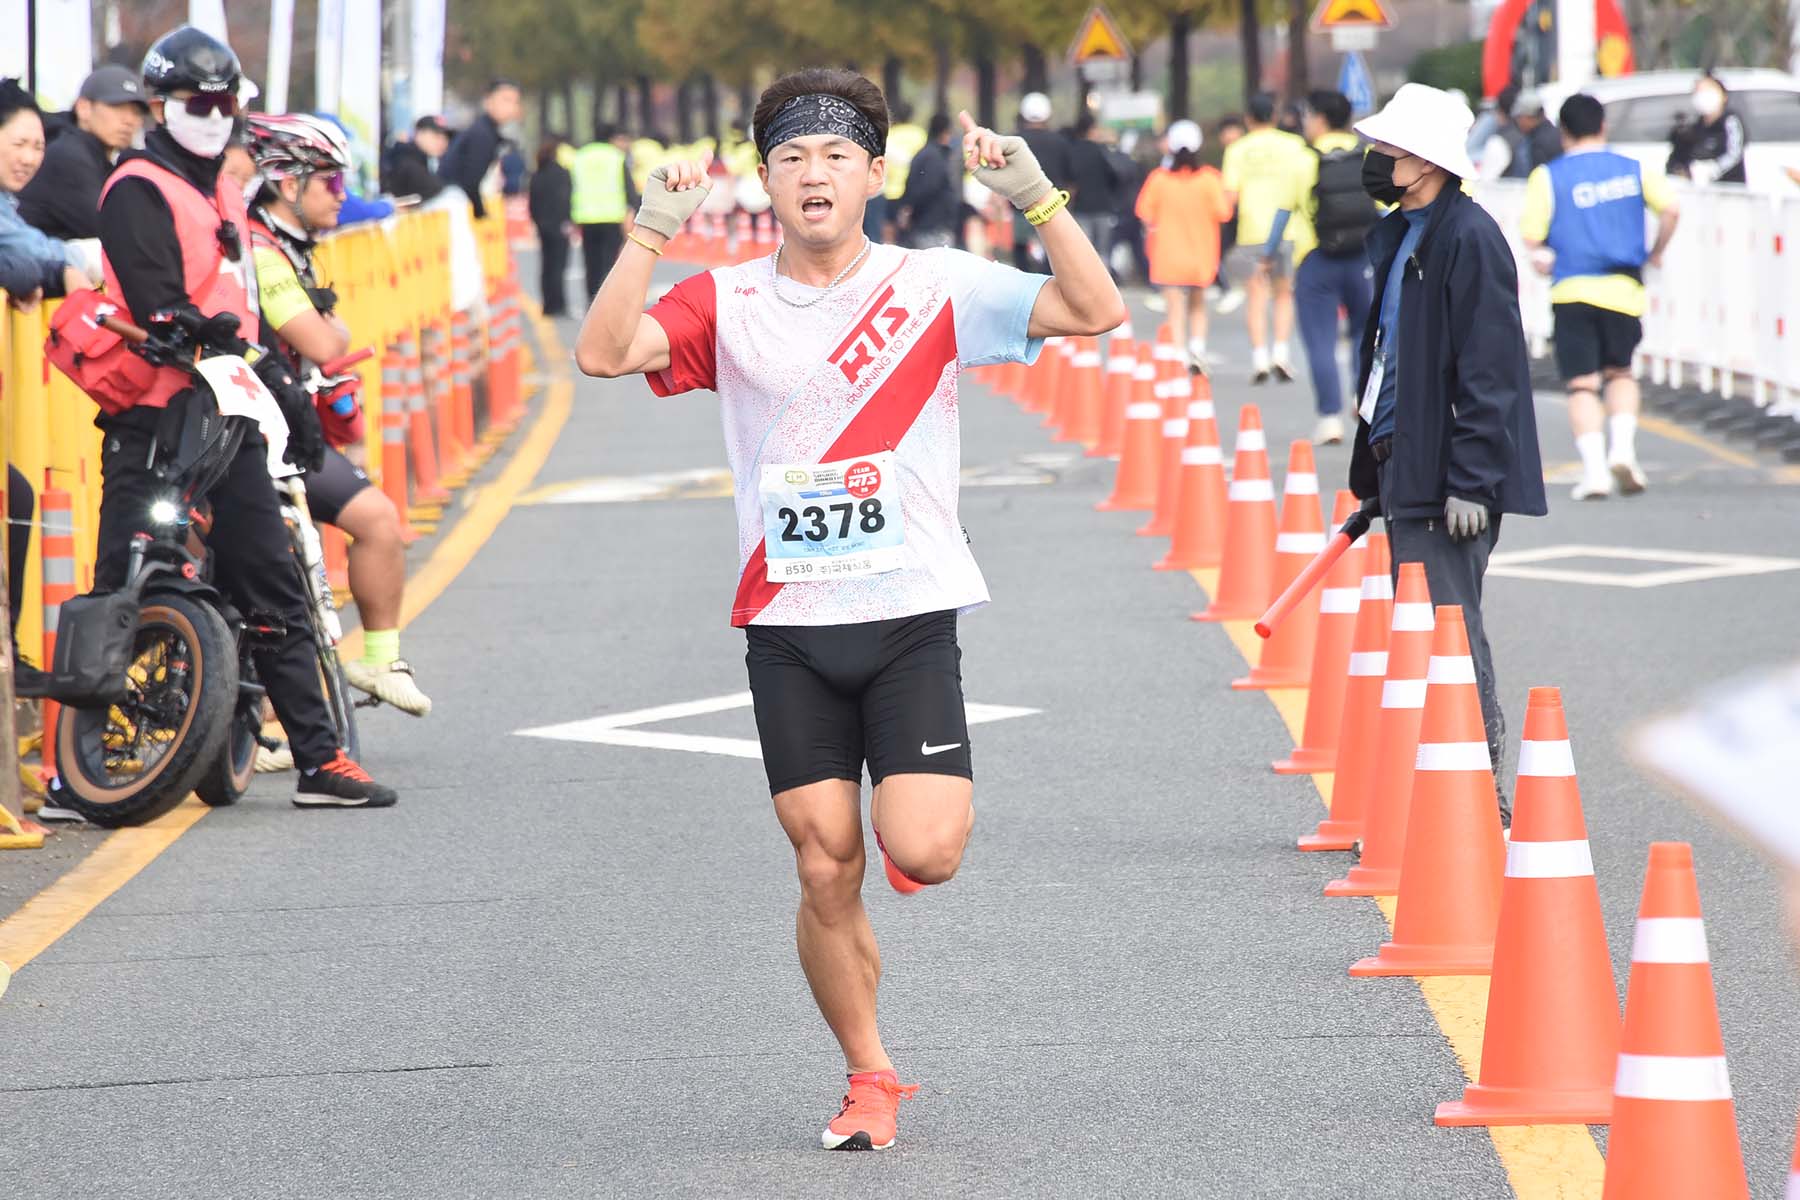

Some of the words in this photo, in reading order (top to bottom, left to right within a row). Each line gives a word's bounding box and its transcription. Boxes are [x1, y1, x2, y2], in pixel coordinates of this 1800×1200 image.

[847, 355, 892, 405] RUNNING
[888, 339, 904, 355] TO
[901, 317, 922, 339] THE
[919, 292, 938, 318] SKY
[853, 466, 870, 474] TEAM
[778, 497, 885, 542] 2378
[785, 563, 813, 576] B530
